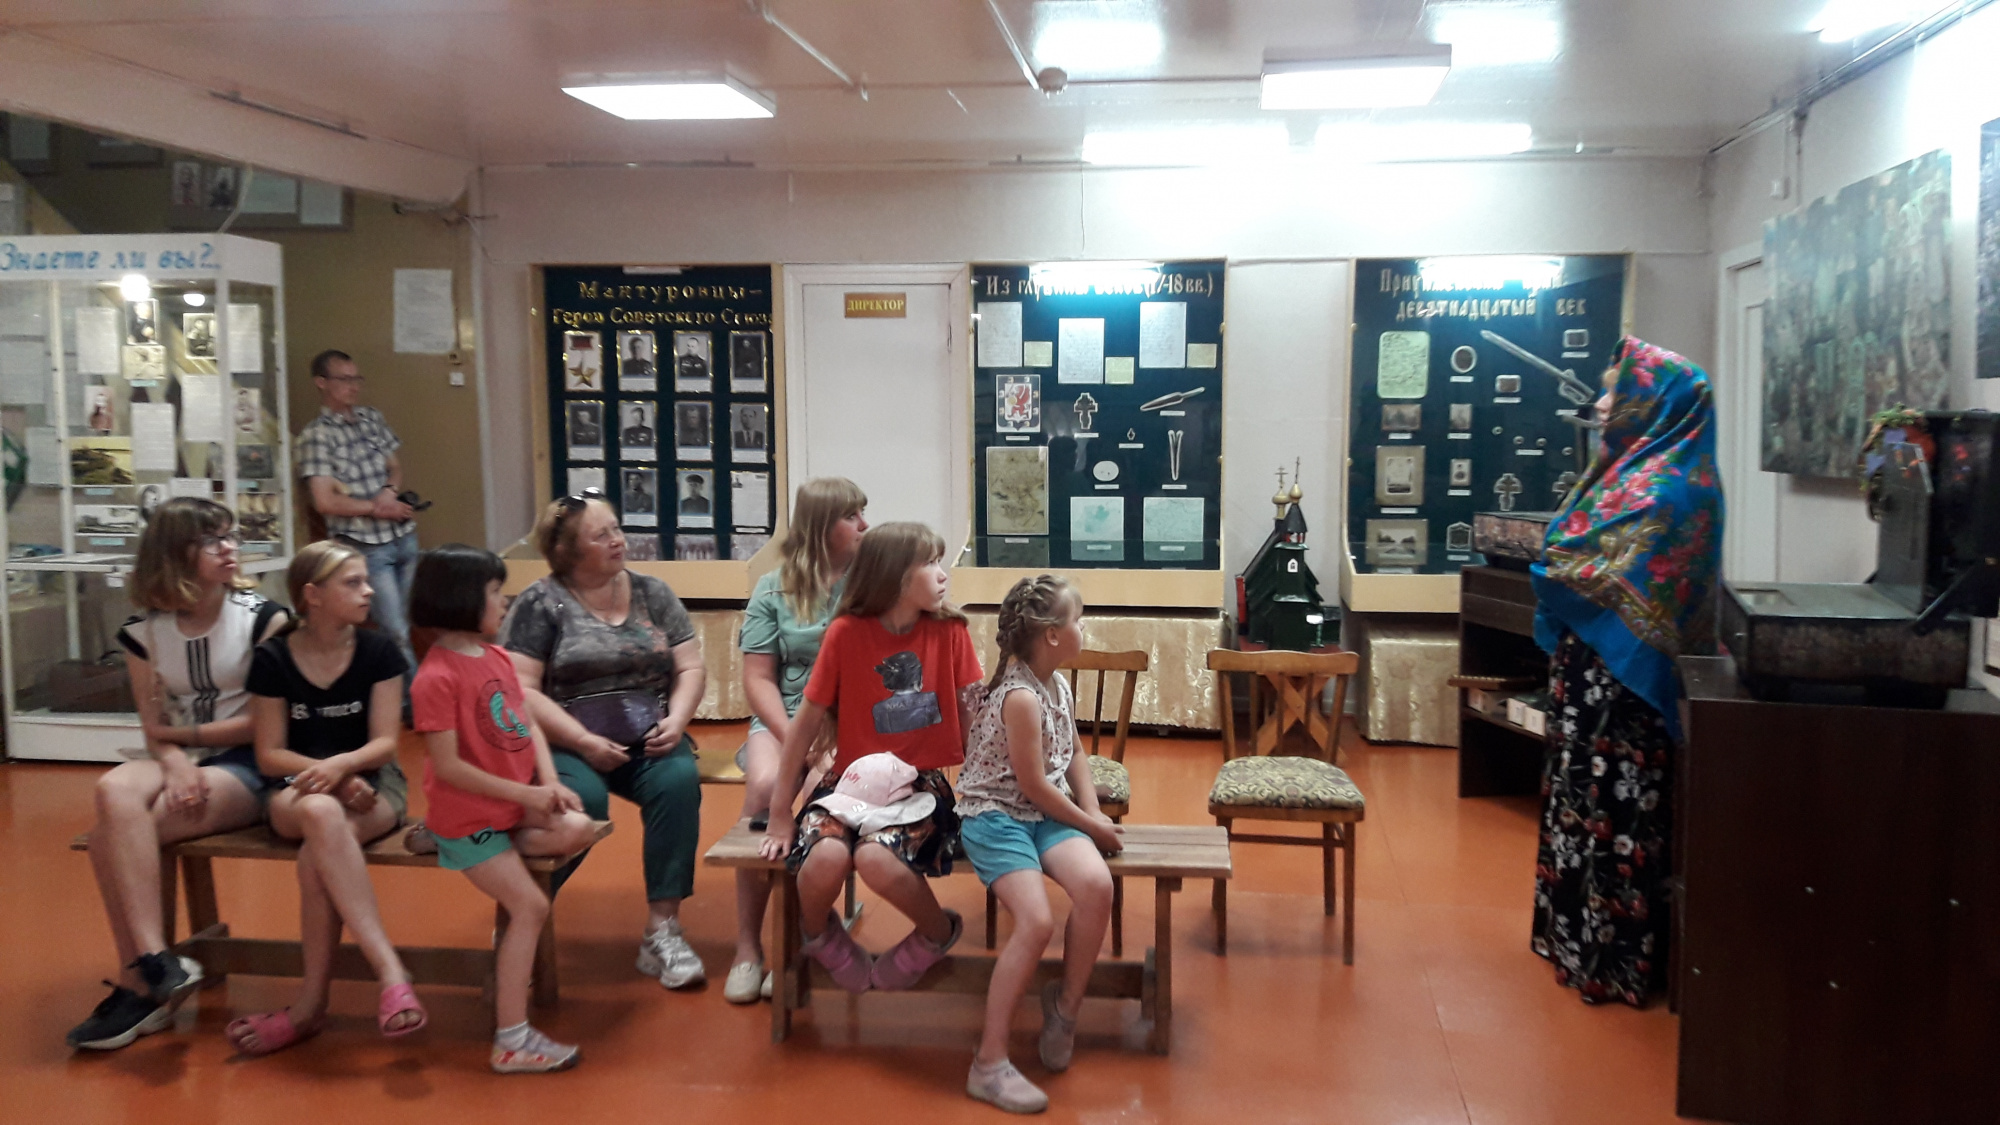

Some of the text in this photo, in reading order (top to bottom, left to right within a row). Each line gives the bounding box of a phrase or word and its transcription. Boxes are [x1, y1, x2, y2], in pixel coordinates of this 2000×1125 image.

[0, 242, 101, 271] Знаете
[109, 251, 147, 270] ли
[986, 275, 1010, 296] Из
[846, 299, 904, 311] ДИРЕКТОР
